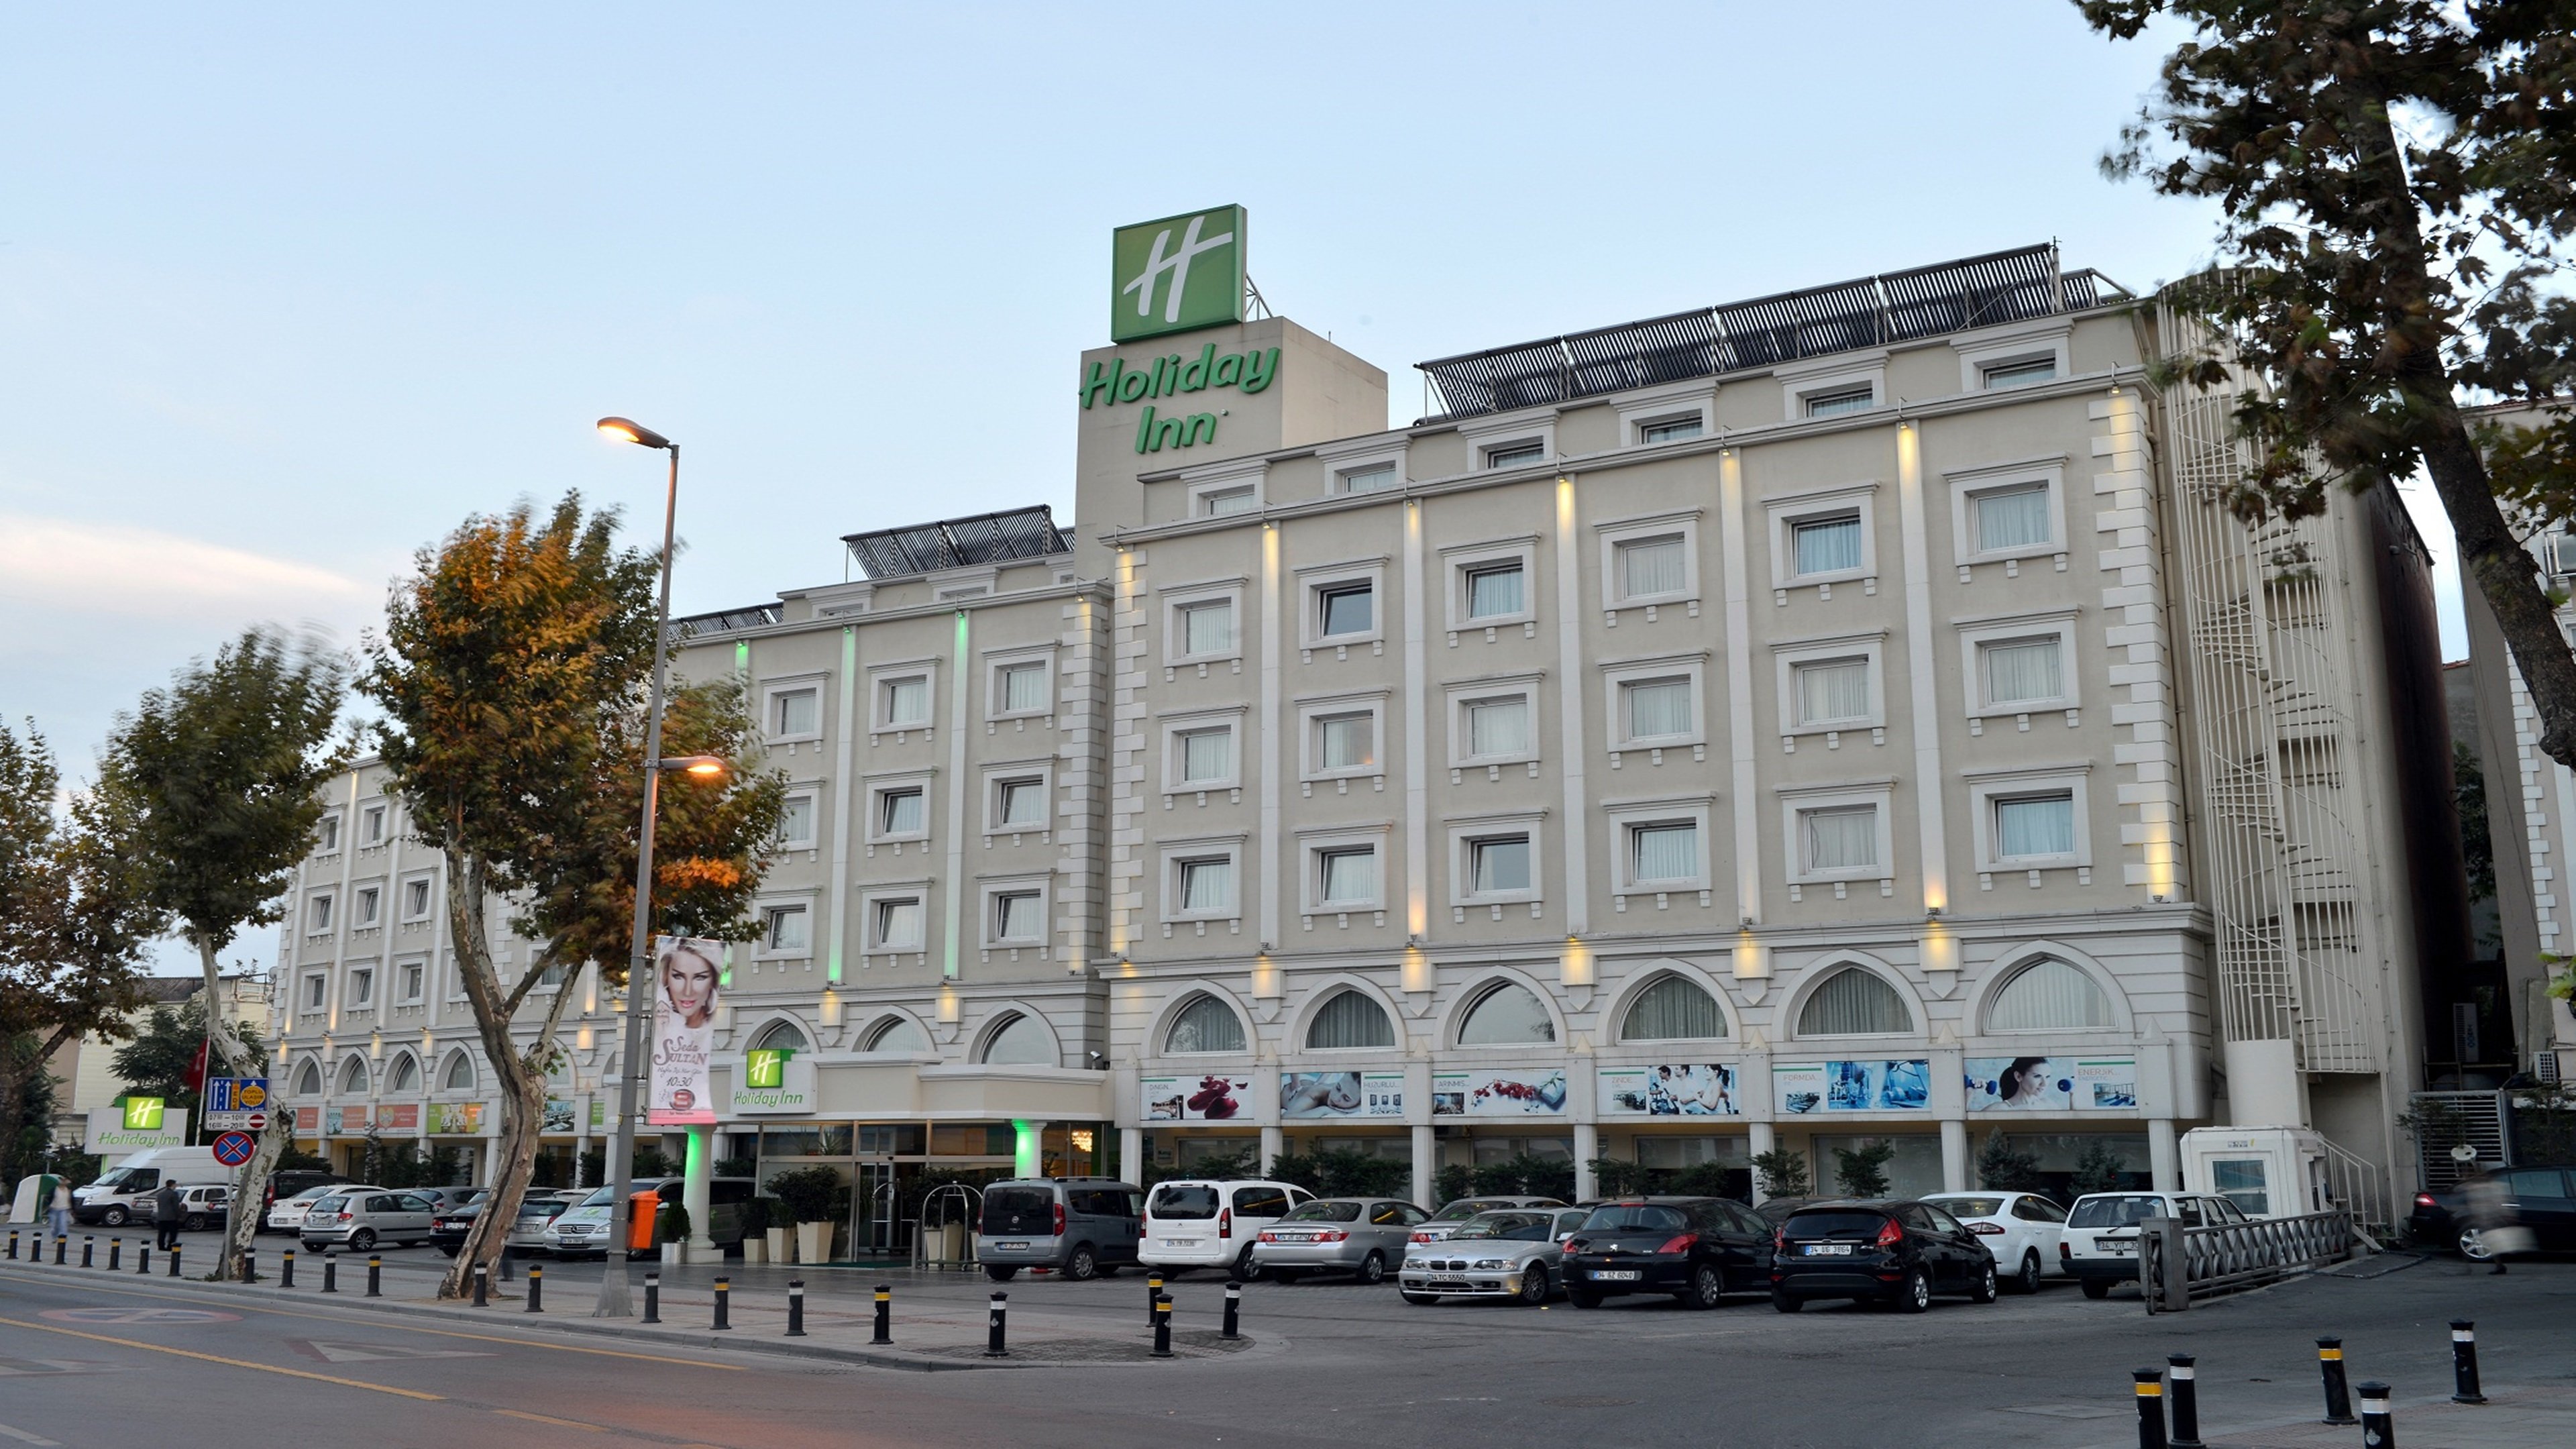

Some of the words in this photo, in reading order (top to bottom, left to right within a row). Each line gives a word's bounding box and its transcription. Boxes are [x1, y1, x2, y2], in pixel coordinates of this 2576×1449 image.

[1123, 216, 1232, 323] H
[1079, 343, 1280, 410] Holiday
[1134, 406, 1217, 454] Inn
[671, 1036, 700, 1052] Seda
[666, 1077, 692, 1087] 10:30
[734, 1090, 777, 1108] Holiday
[780, 1090, 803, 1104] Inn
[97, 1132, 157, 1147] Holiday
[159, 1132, 180, 1145] Inn
